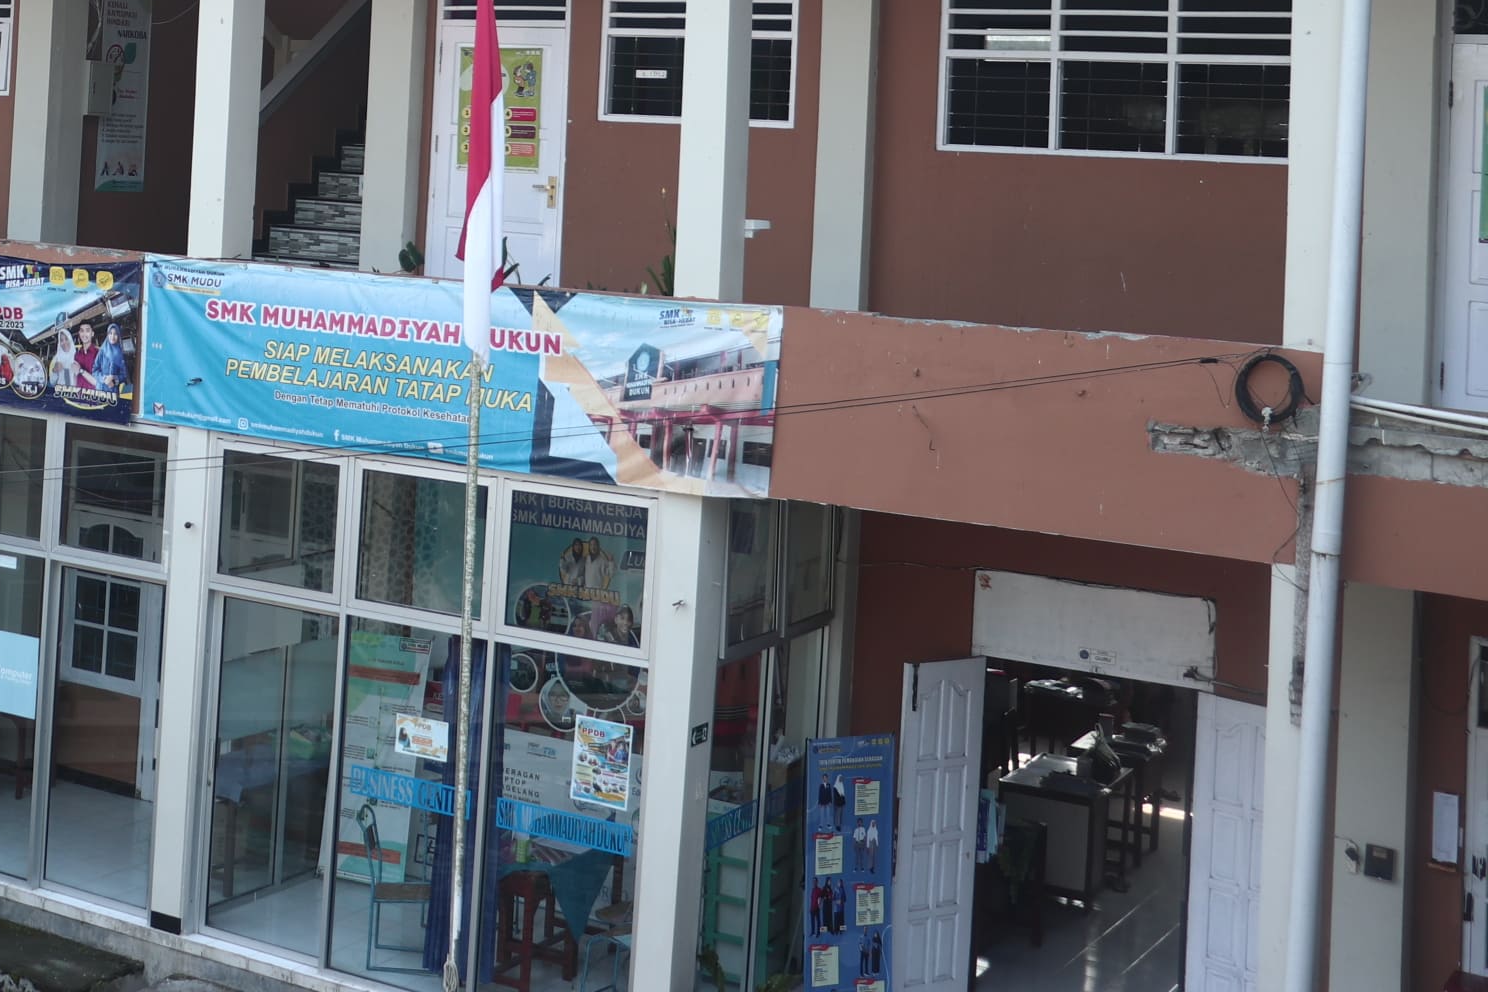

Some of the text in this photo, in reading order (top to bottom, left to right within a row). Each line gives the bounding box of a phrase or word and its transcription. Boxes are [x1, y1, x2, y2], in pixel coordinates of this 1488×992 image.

[0, 265, 24, 281] SMK
[6, 278, 44, 288] BISA-HEBAT
[167, 273, 222, 288] SMK MUDU
[659, 309, 680, 320] SMK
[206, 299, 562, 356] SMK MUHAMMADIYAH UKUN
[264, 340, 310, 360] SIAP
[20, 382, 38, 394] TKJ
[225, 358, 390, 396] PEMBELAJARAN
[394, 378, 463, 403] TATAP
[53, 384, 117, 406] SMK MUDU
[274, 391, 307, 403] Dengan
[310, 396, 334, 407] Tetap
[336, 399, 379, 412] Mematuhi
[382, 404, 420, 417] Protokol
[513, 509, 537, 524] SMK
[548, 498, 594, 513] BURSA
[596, 503, 642, 518] KERJA
[548, 583, 621, 606] SMK MUDU
[582, 727, 606, 738] PPDB
[352, 767, 414, 804] BUSINESS
